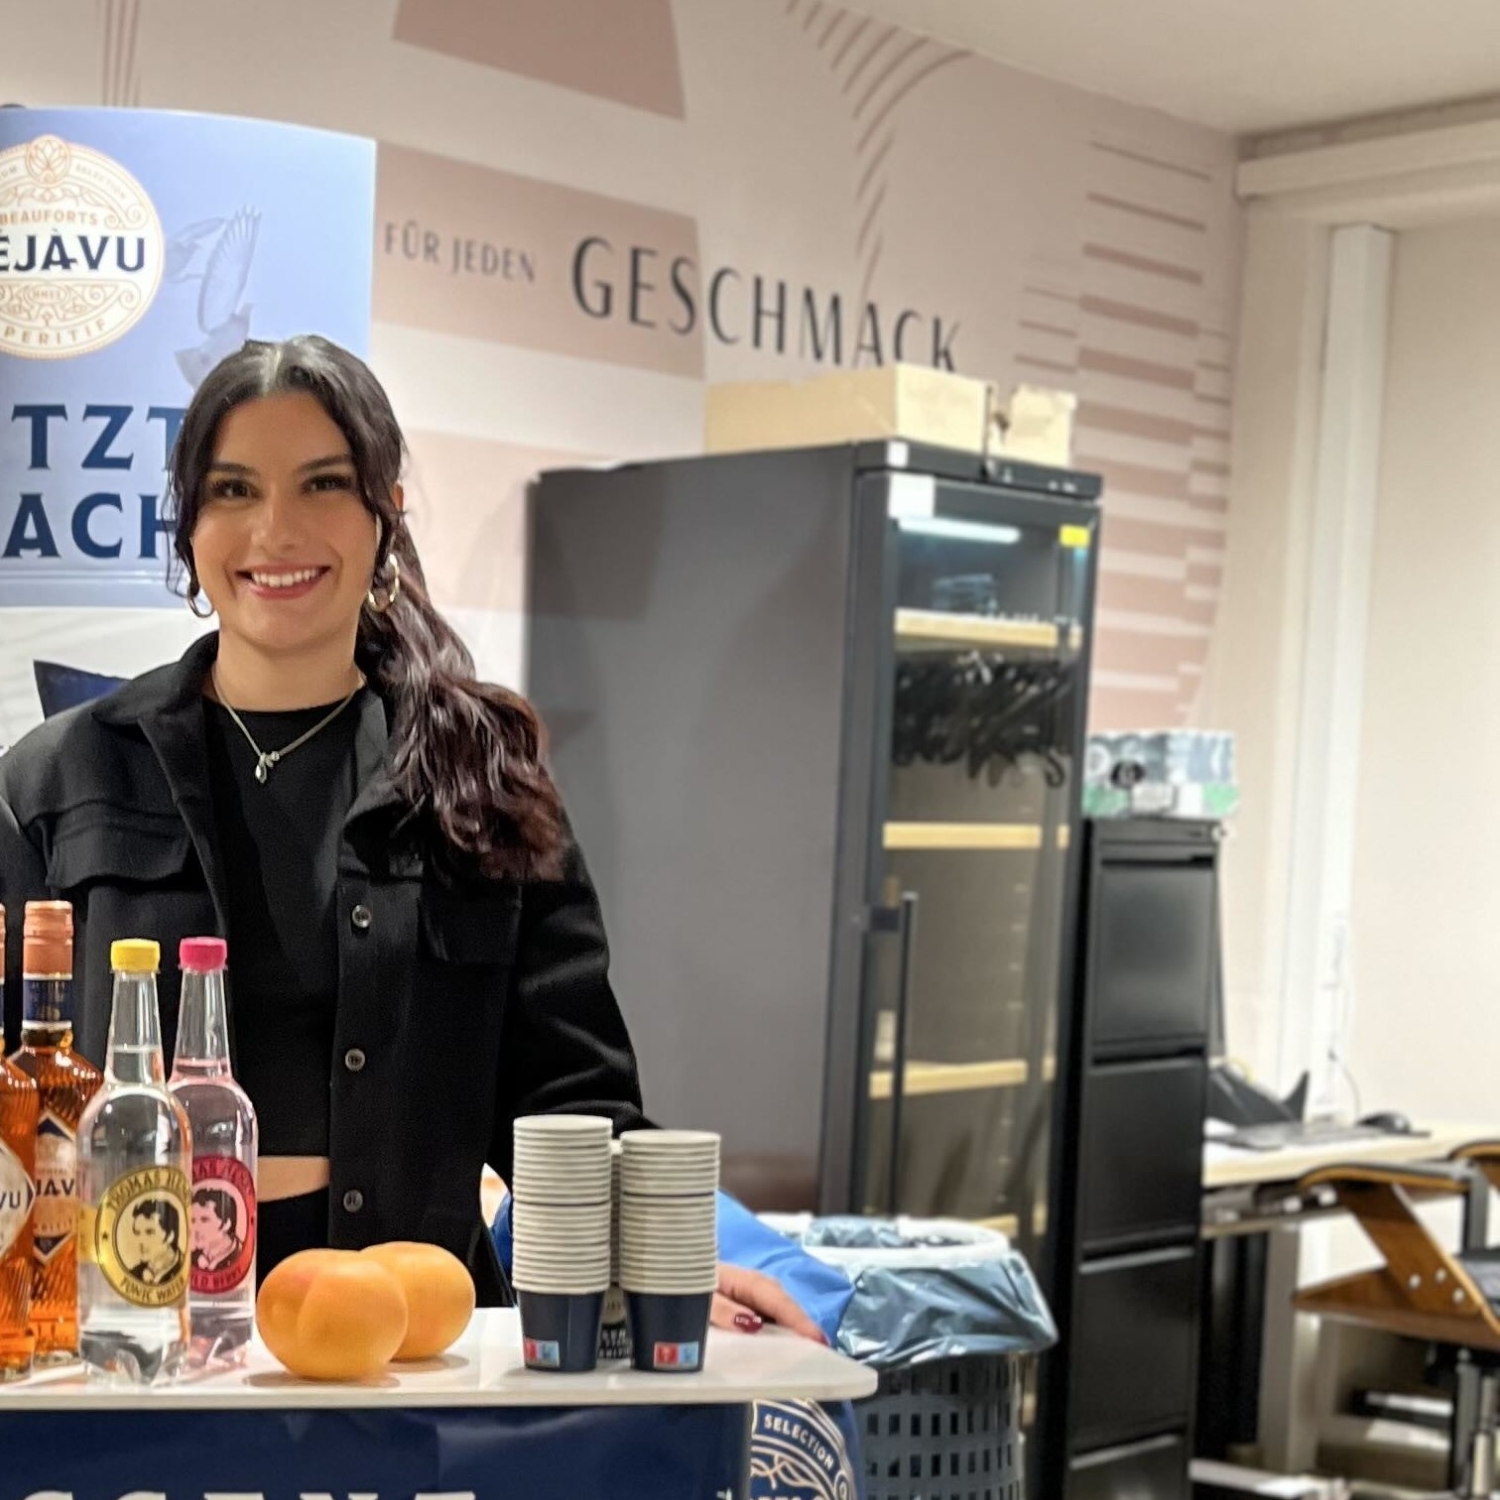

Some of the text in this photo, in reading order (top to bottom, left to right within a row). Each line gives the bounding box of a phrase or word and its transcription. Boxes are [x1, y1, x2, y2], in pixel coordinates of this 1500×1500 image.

[0, 208, 99, 226] BEAUFORTS
[384, 219, 962, 374] FÜR JEDEN GESCHMACK
[763, 1413, 835, 1470] SELECTION
